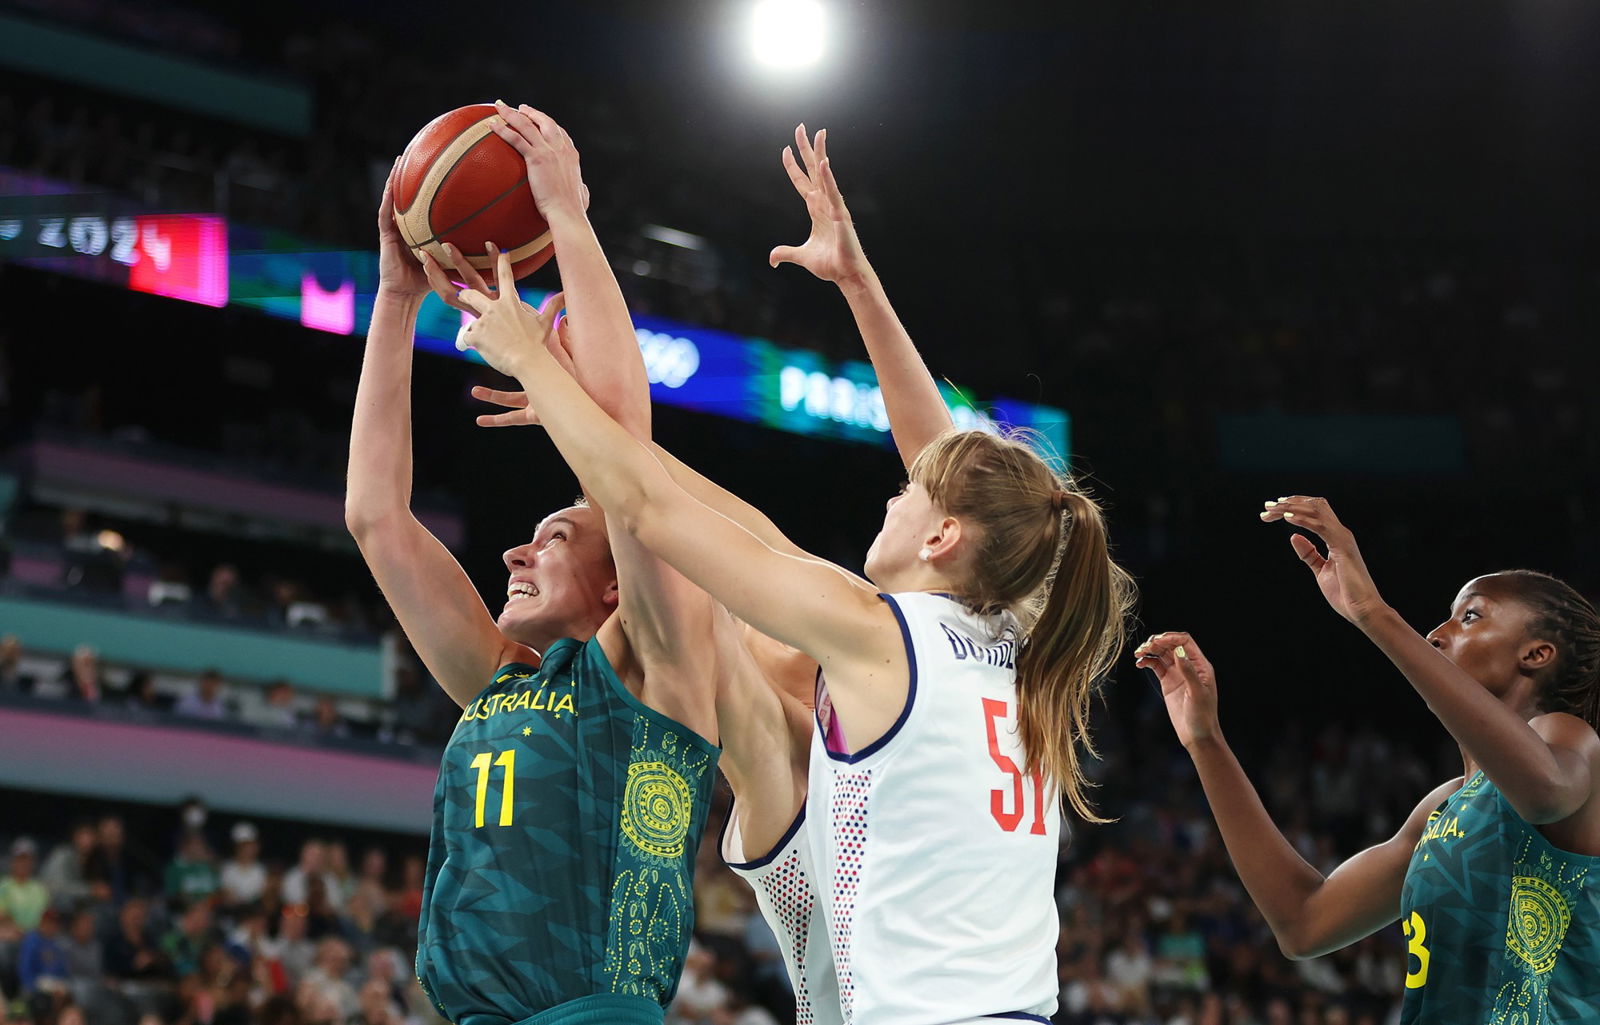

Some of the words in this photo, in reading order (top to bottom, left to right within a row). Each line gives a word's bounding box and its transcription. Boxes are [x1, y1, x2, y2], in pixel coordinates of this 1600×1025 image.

[458, 688, 575, 724] USTRALIA
[470, 749, 515, 828] 11
[981, 697, 1046, 836] 51
